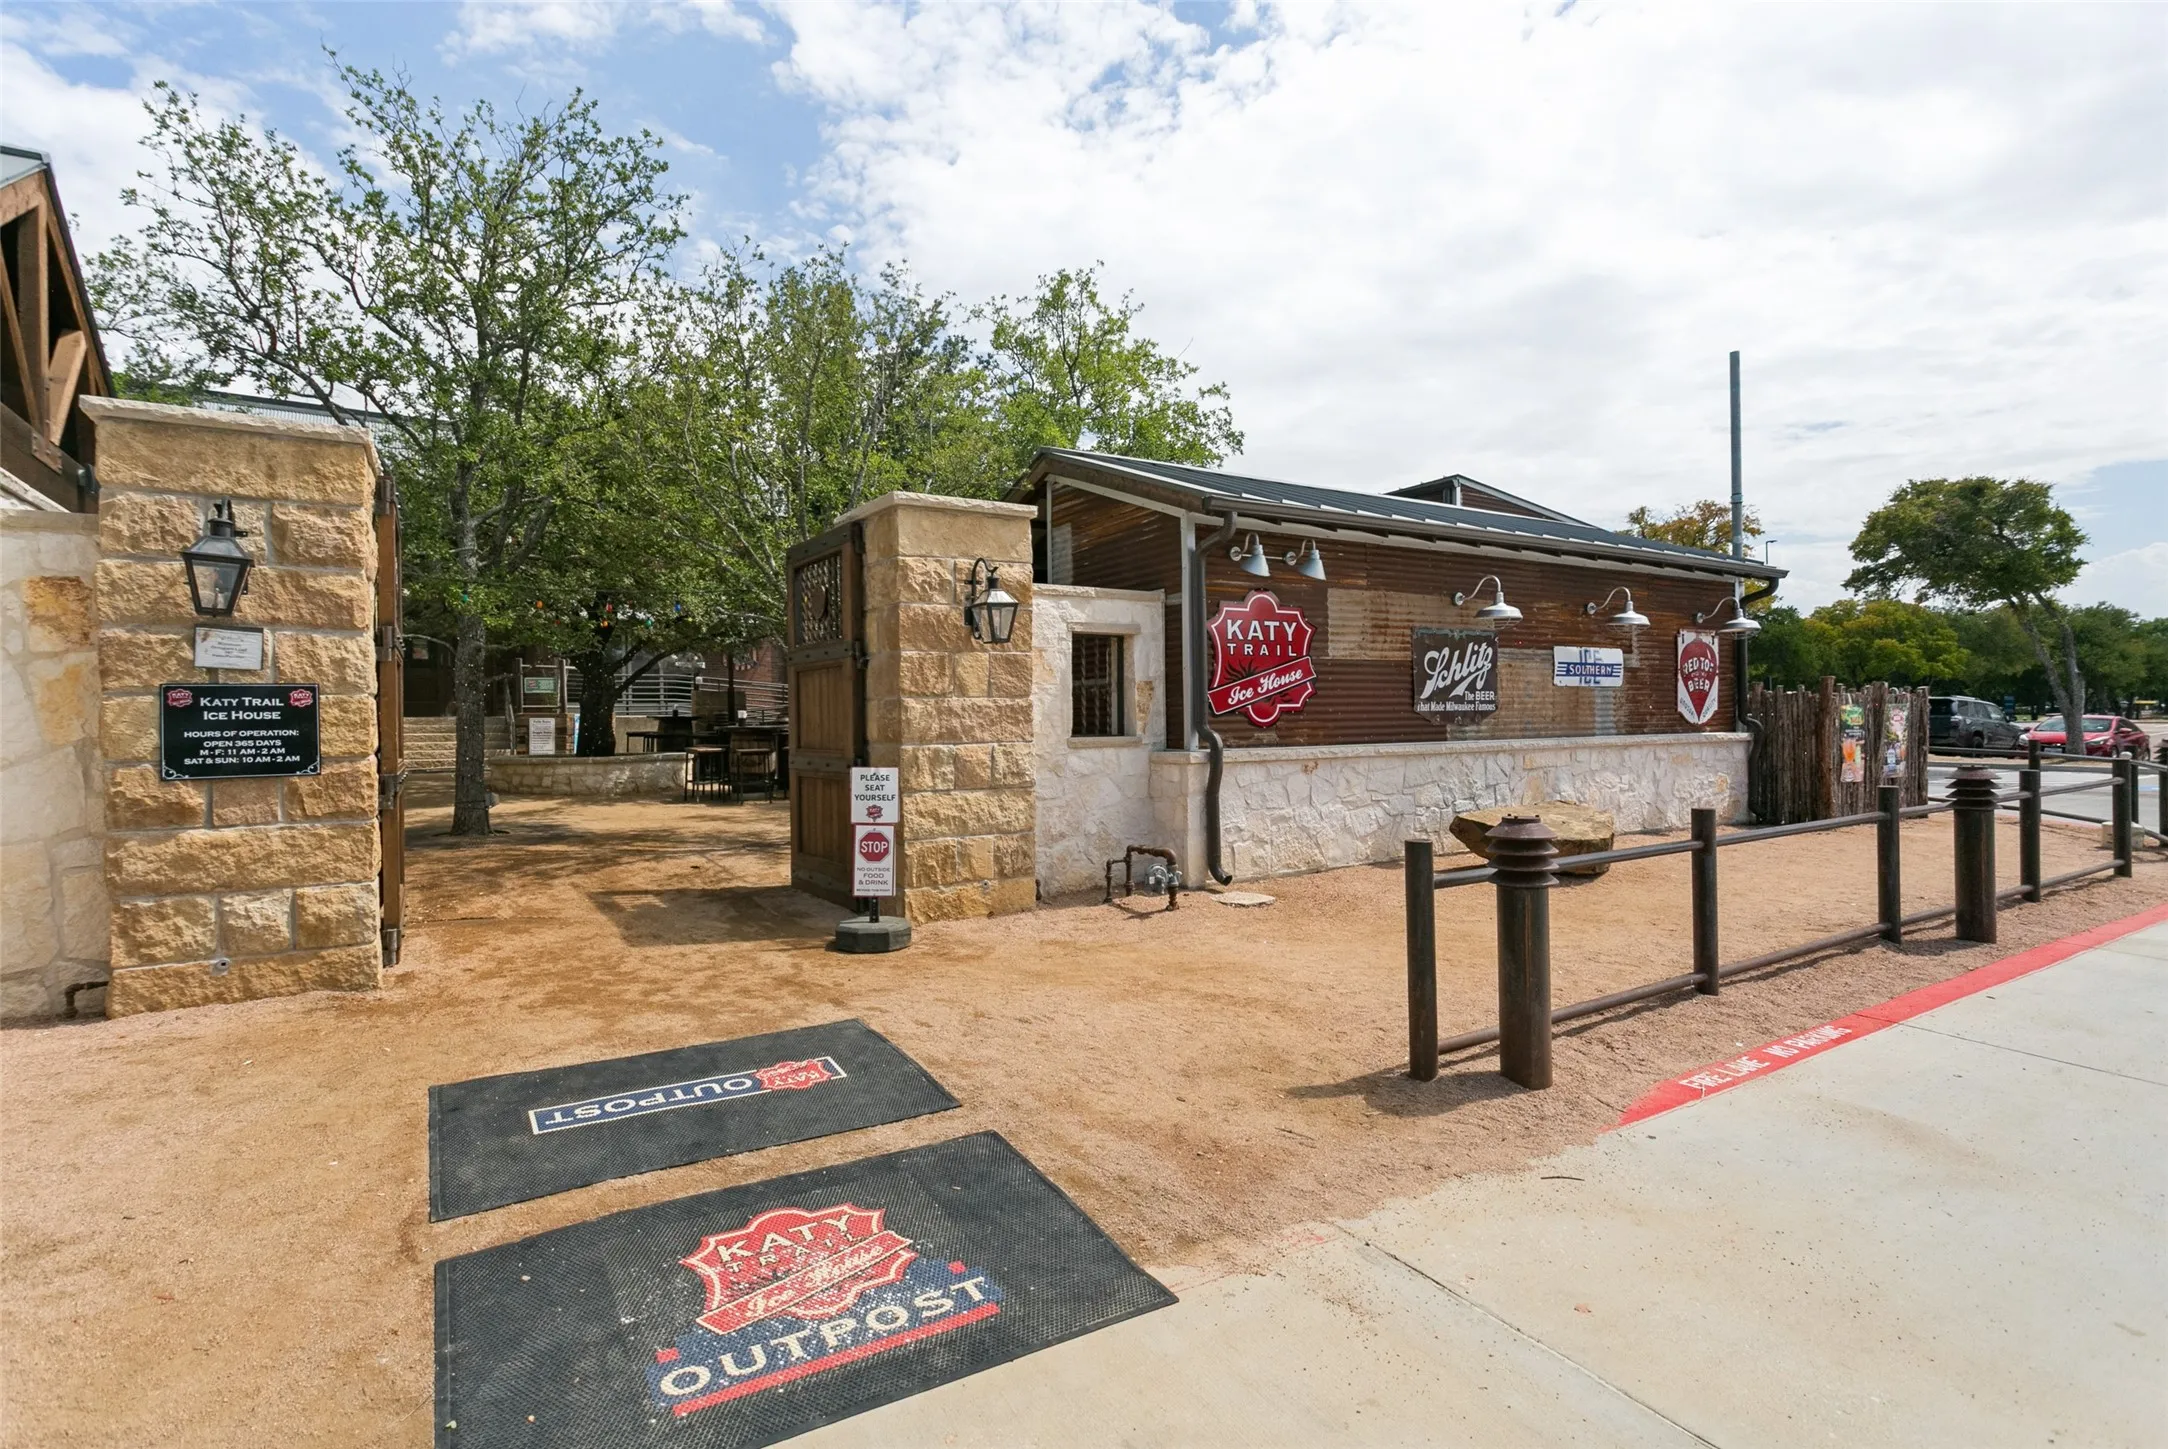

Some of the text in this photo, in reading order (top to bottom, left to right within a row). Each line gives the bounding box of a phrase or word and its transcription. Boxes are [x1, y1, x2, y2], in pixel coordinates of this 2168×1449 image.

[1226, 618, 1298, 642] KATY
[1226, 642, 1298, 657] TRAIL
[1420, 642, 1494, 699] Schlitz
[1569, 664, 1612, 676] SOUTHERN
[1227, 669, 1304, 705] Ice House
[1687, 677, 1711, 692] BEER
[1464, 690, 1495, 700] The BEER
[200, 697, 239, 707] KATY
[241, 697, 285, 706] TRAIL
[1430, 701, 1446, 711] Made
[1446, 701, 1475, 711] Milwaukee
[1475, 701, 1496, 711] Famous
[203, 711, 281, 720] ICE HOUSE
[239, 729, 299, 737] OPERATION:
[203, 740, 233, 748] OPEN
[276, 755, 283, 763] 2
[860, 774, 891, 782] PLEASE
[860, 841, 888, 853] STOP
[1678, 1025, 1853, 1090] FIRE LANE NO PARKING
[545, 1078, 753, 1125] OUTPOST
[717, 1214, 851, 1263] KATY
[724, 1233, 864, 1274] TRAIL
[660, 1276, 986, 1396] OUTPOST
